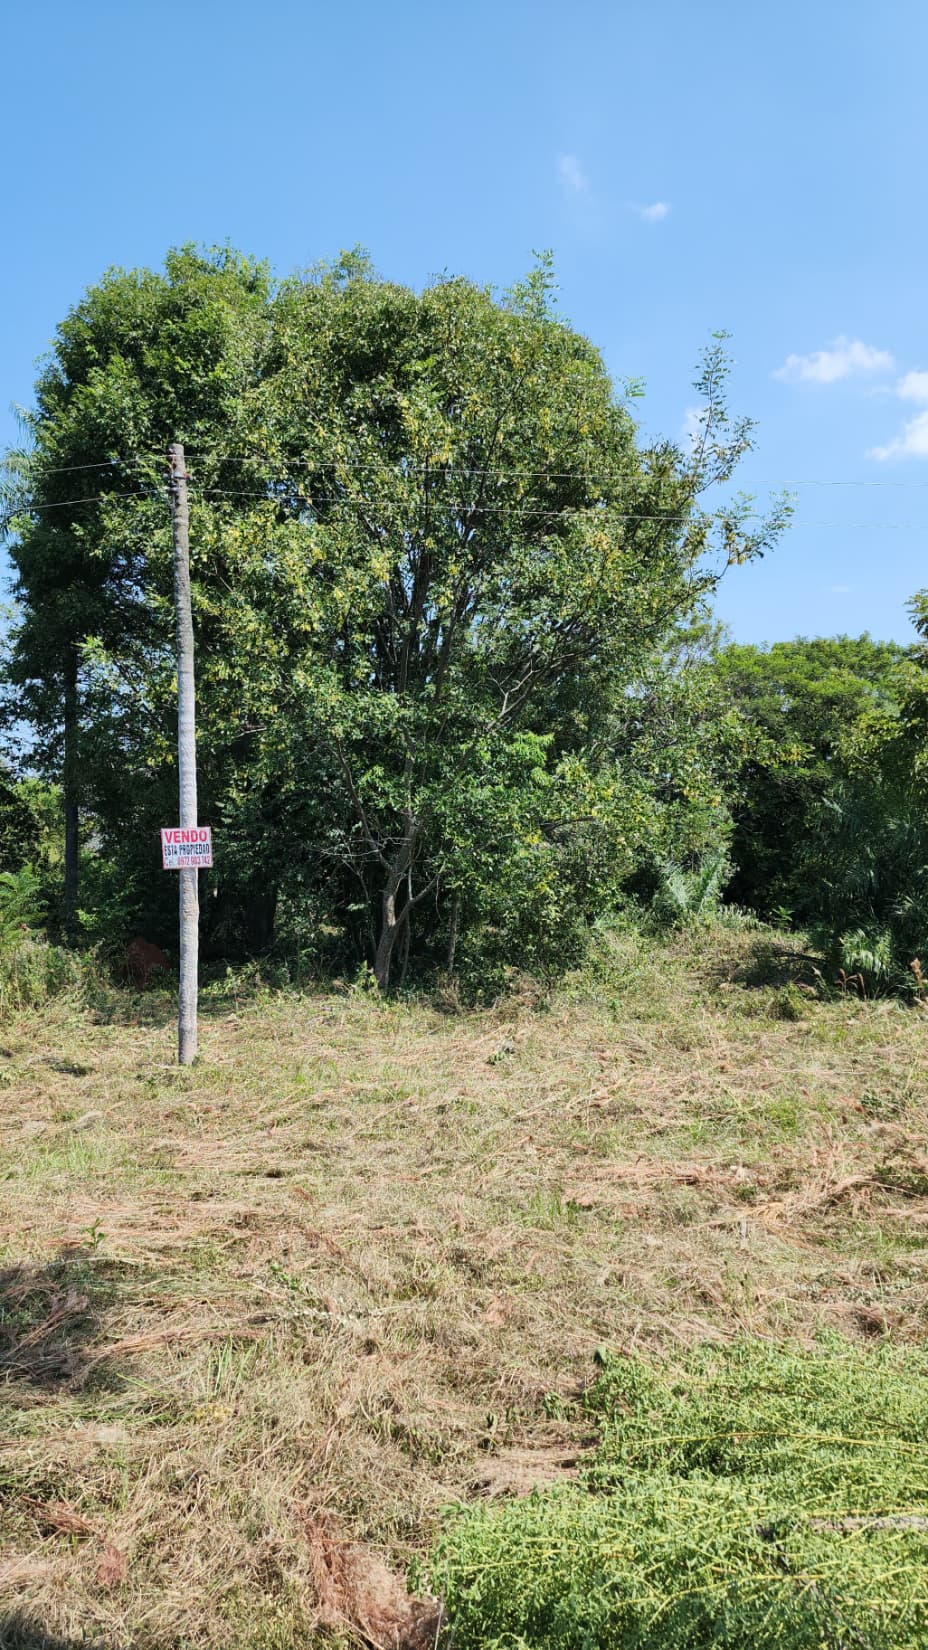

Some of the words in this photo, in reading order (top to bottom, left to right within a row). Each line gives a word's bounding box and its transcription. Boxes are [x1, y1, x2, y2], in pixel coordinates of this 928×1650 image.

[164, 830, 208, 843] VENDO
[164, 845, 178, 856] ESTA
[179, 843, 210, 855] PROPIEDAD
